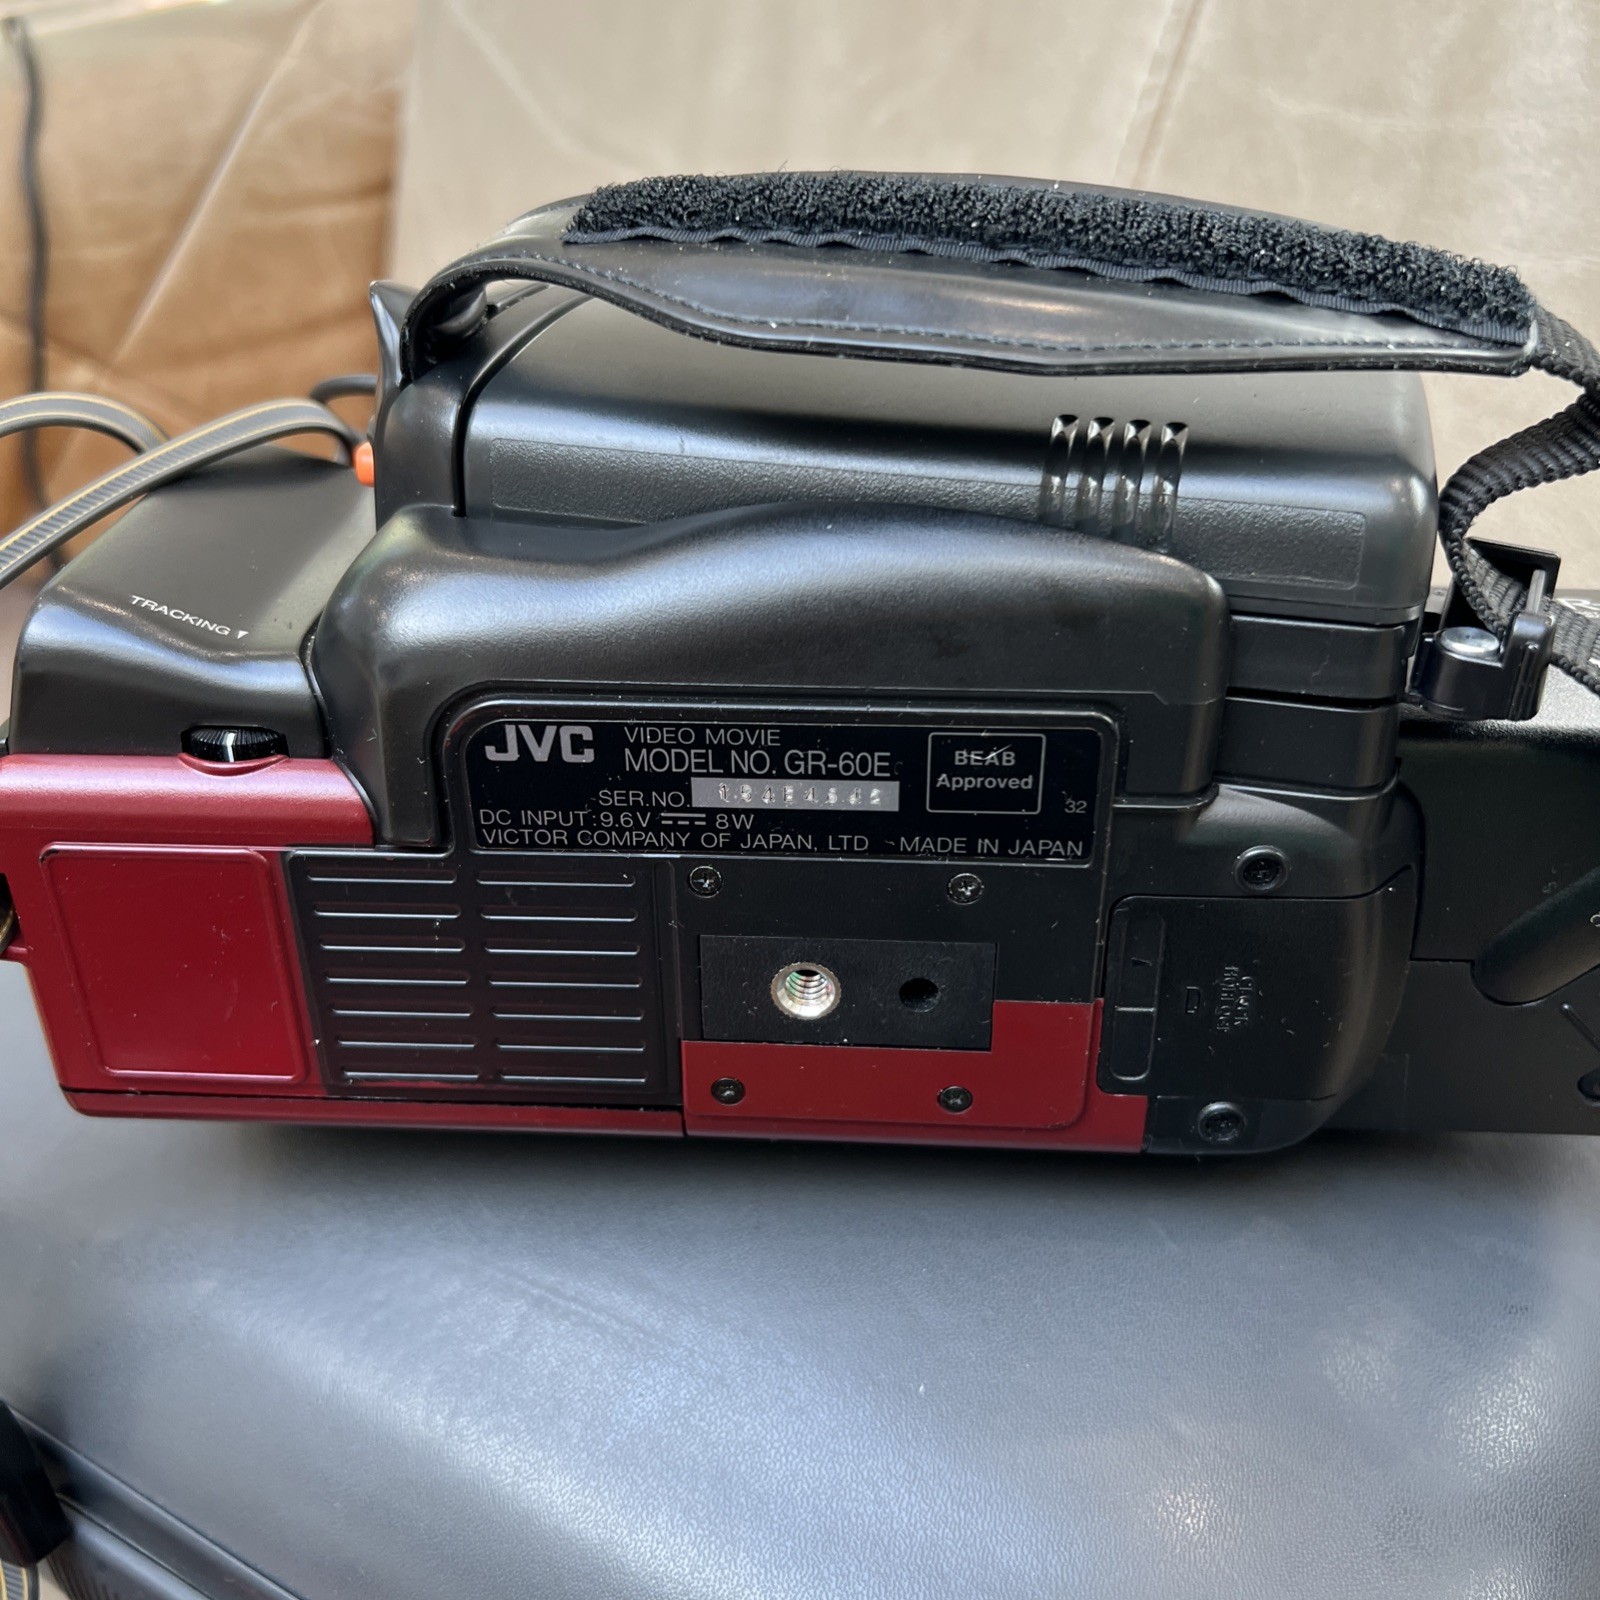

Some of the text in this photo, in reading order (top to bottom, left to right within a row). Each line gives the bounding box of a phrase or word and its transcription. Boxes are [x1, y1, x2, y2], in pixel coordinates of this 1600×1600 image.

[131, 594, 231, 636] TRACKING
[485, 724, 595, 763] JVC
[624, 726, 781, 746] VIDEO MOVIE
[625, 748, 891, 777] MODEL NO. GR-60E
[954, 750, 1016, 767] BEAB
[936, 773, 1033, 791] Approved
[480, 809, 511, 825] DC
[1064, 800, 1088, 814] 32
[482, 828, 568, 846] VICTOR
[577, 830, 690, 848] COMPANY
[701, 832, 731, 849] OF
[828, 835, 869, 850] LTD
[900, 836, 1083, 857] MADE IN JAPAN
